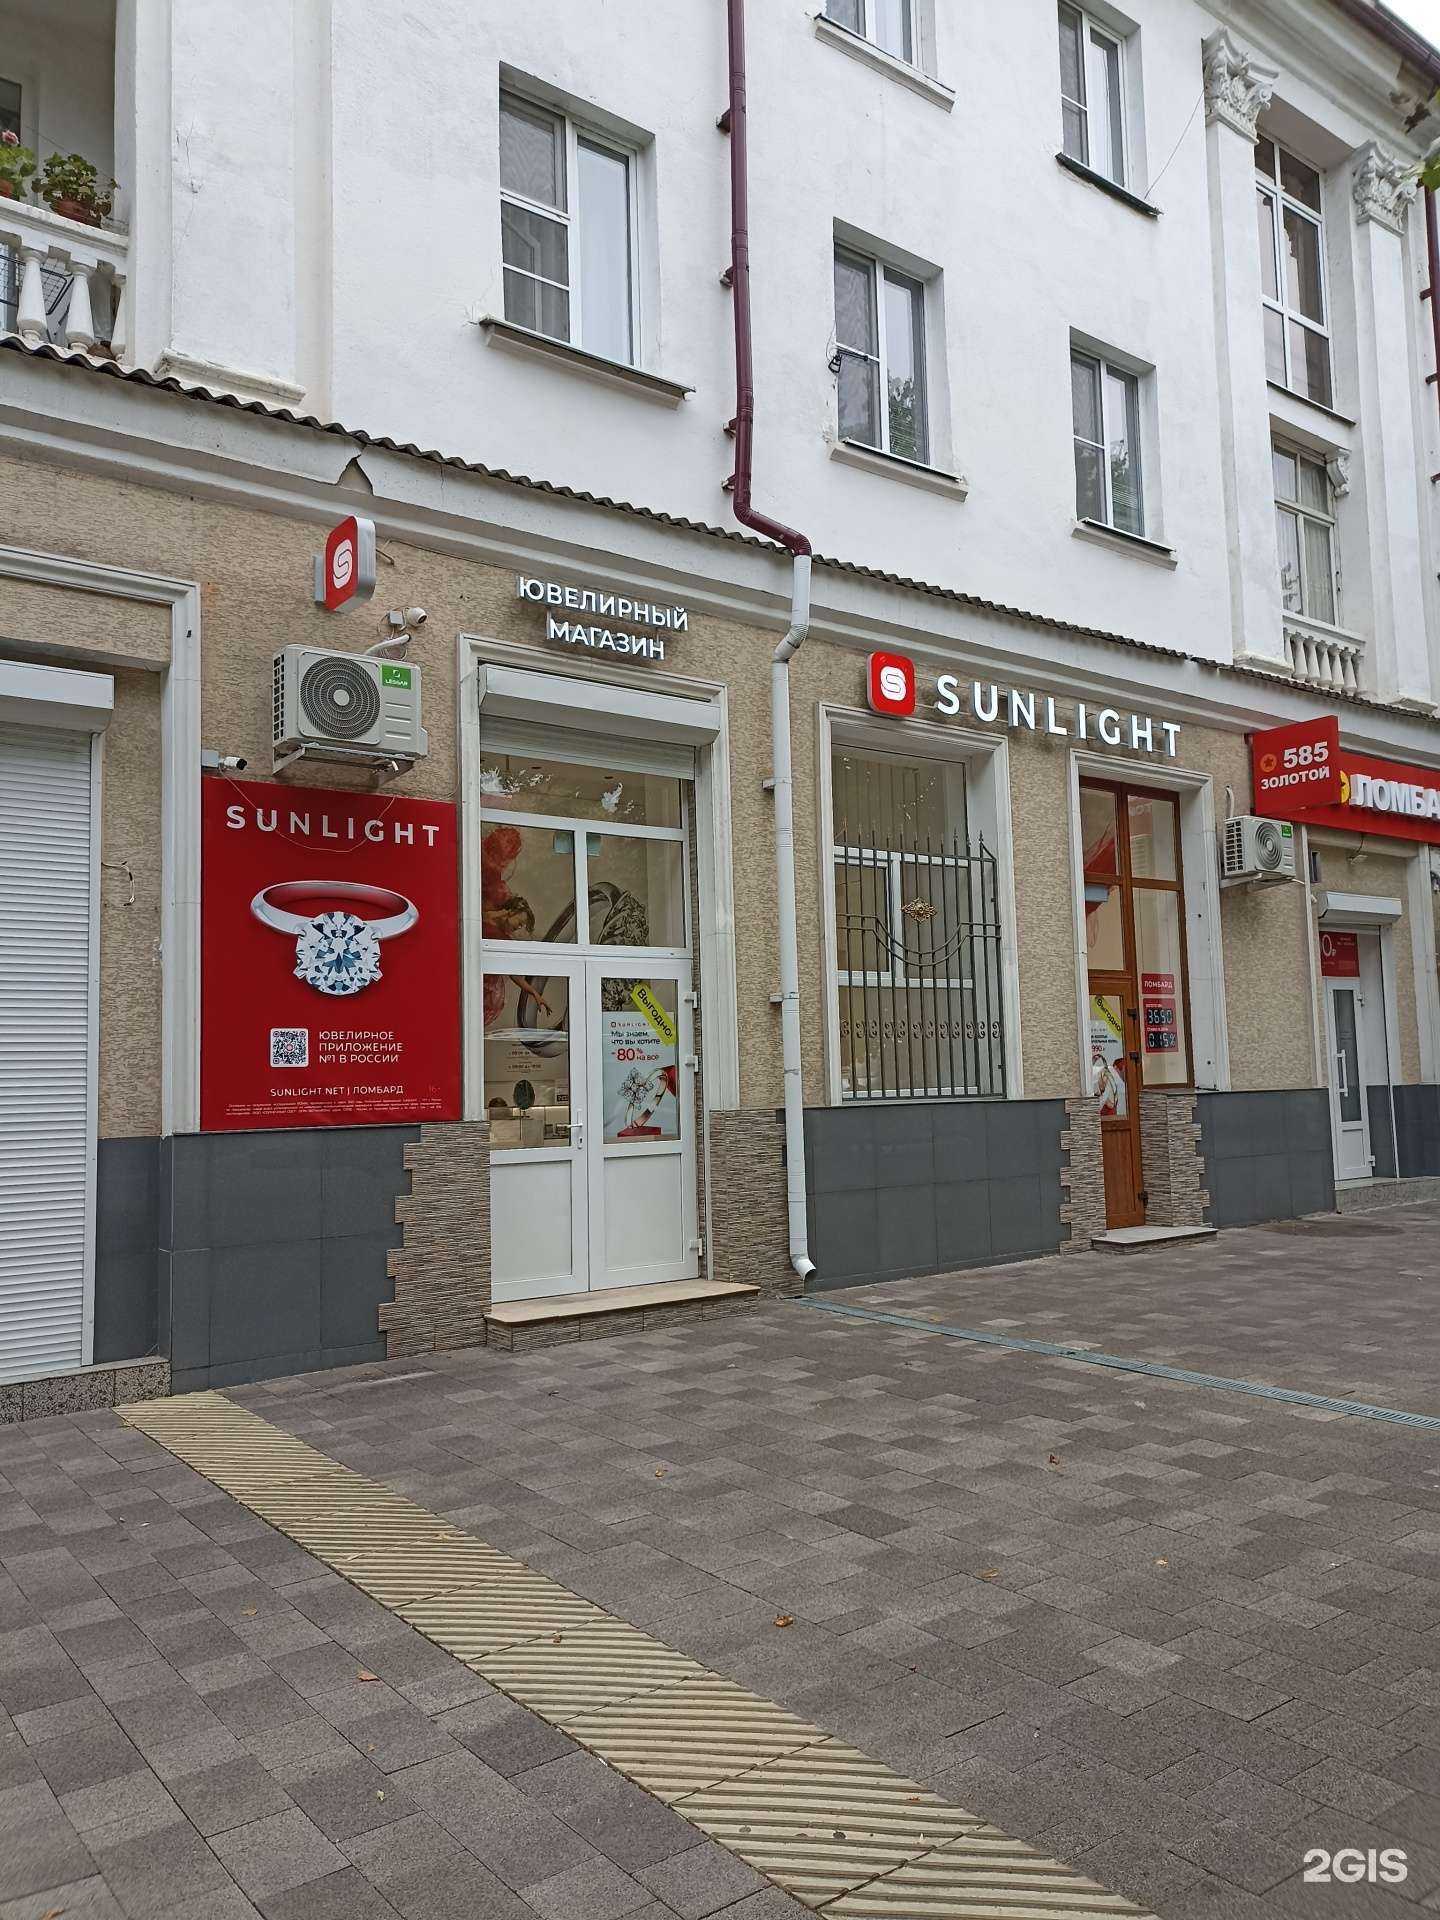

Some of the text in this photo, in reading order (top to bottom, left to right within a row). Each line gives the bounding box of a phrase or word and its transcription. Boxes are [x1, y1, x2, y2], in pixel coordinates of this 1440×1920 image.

[518, 576, 689, 631] ЮВЕЛИРНЫЙ
[547, 618, 665, 660] МАГАЗИН
[935, 674, 1182, 757] SUNLIGHT
[1283, 741, 1329, 769] 585
[1260, 765, 1330, 790] ЗОЛОТОЙ
[226, 805, 440, 847] SUNLIGHT
[1144, 980, 1173, 989] ЛОМБАРД
[319, 1031, 395, 1040] ЮВЕЛИРНОЕ
[319, 1042, 404, 1052] ПРИЛОЖЕНИЕ
[319, 1054, 399, 1063] №1 В РОССИИ
[353, 1085, 404, 1094] ЛОМБАРД
